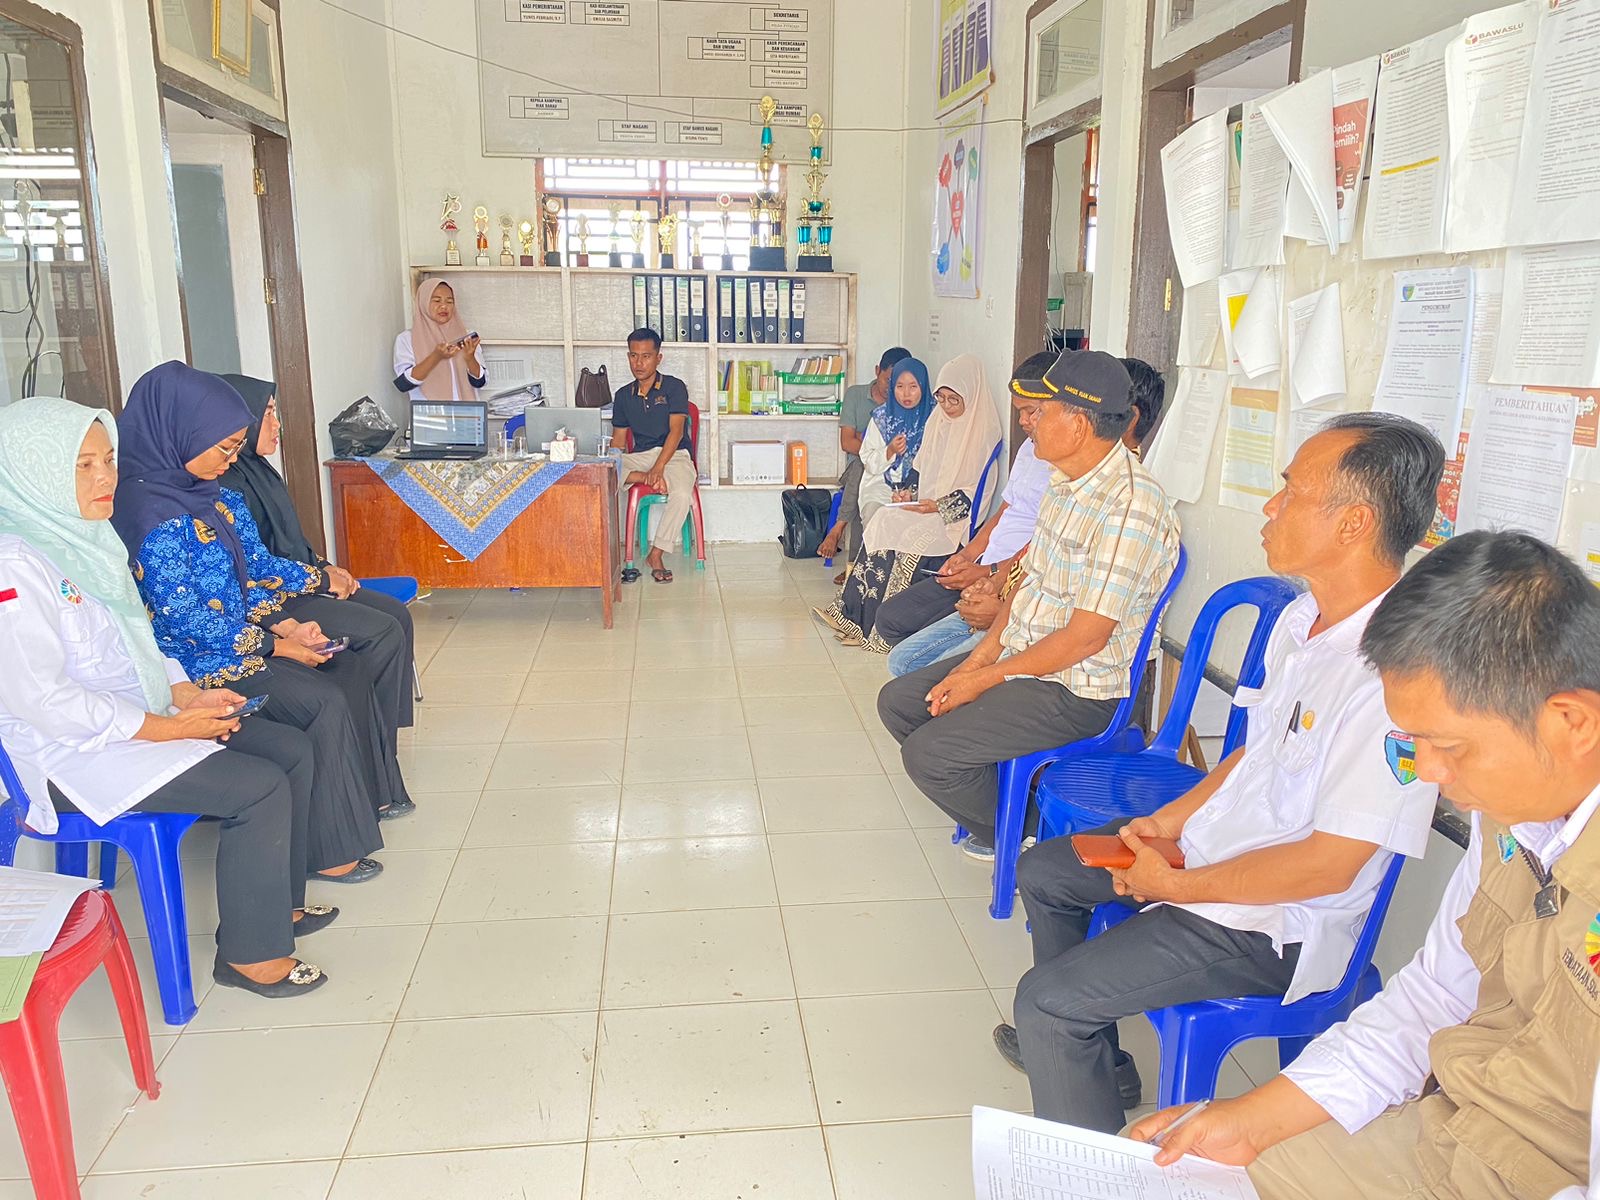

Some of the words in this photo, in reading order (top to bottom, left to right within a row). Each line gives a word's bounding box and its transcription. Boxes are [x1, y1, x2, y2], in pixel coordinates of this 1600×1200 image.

[1478, 22, 1524, 40] BAWASLU
[1335, 134, 1359, 148] emilih?
[1494, 397, 1569, 414] PEMBERITAHUAN
[1562, 947, 1590, 987] PENDATAAN
